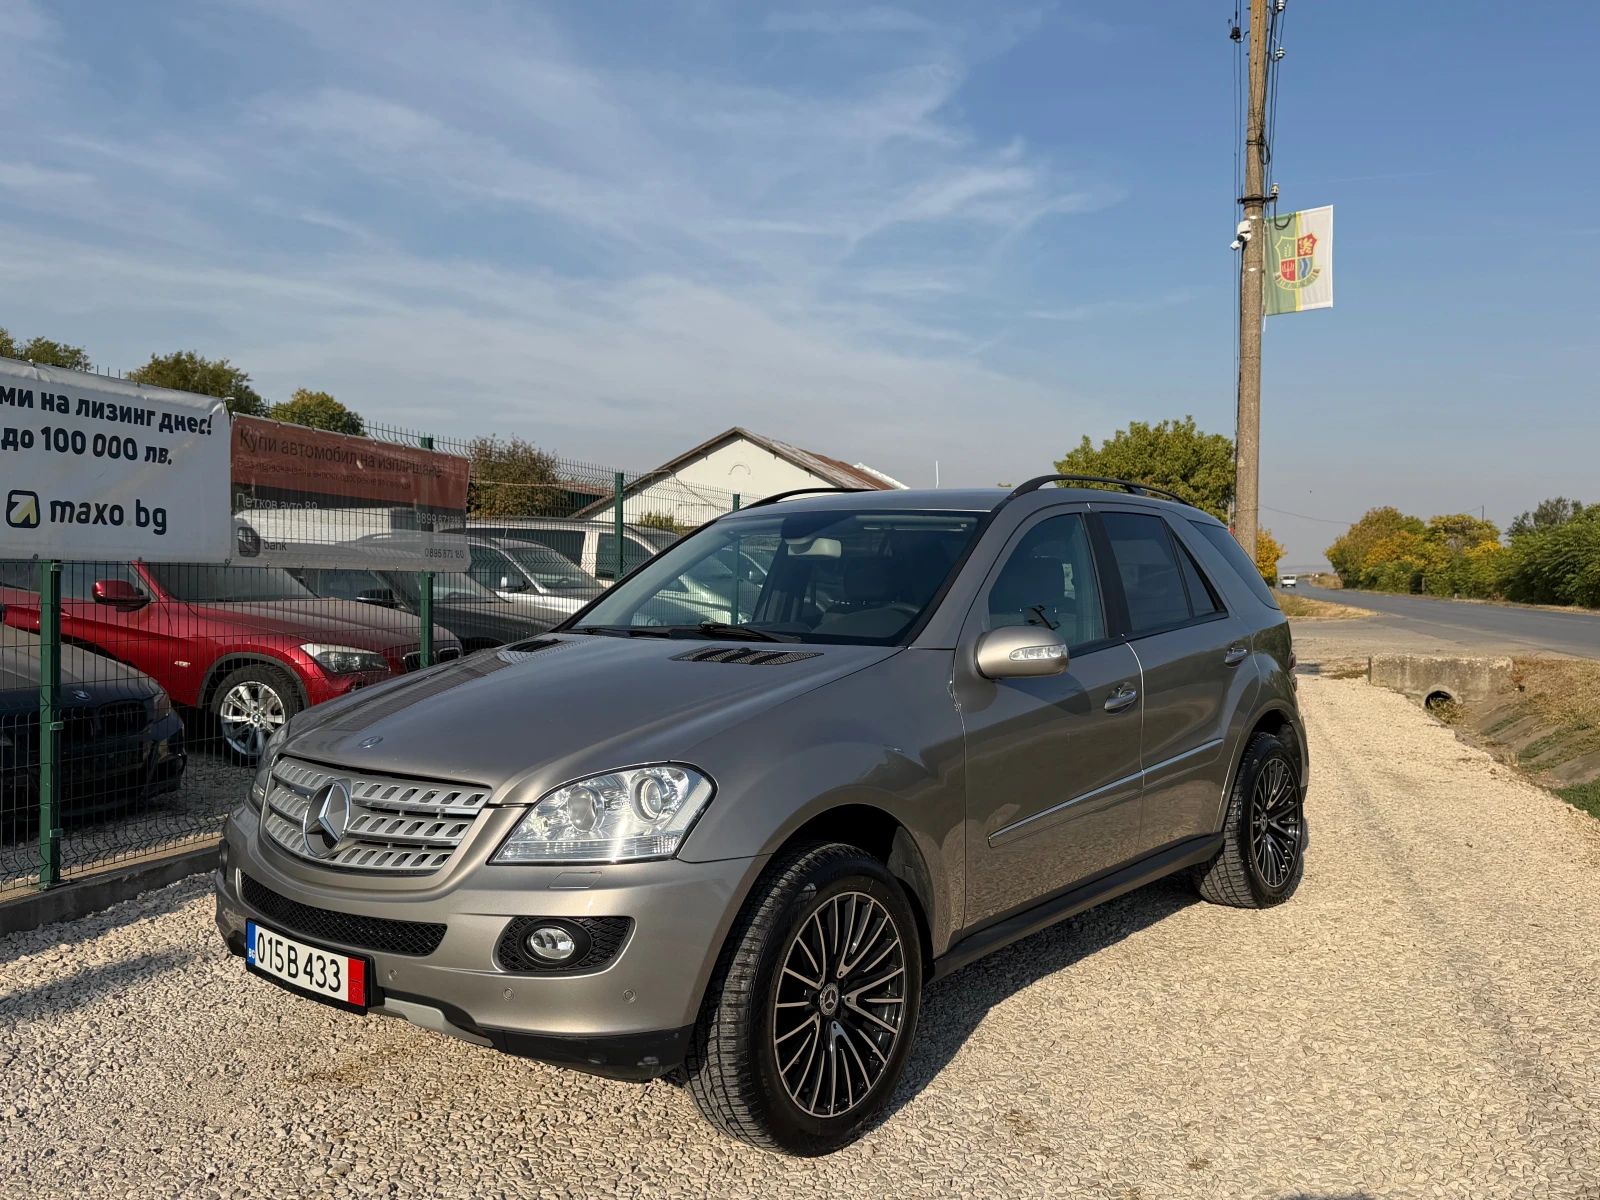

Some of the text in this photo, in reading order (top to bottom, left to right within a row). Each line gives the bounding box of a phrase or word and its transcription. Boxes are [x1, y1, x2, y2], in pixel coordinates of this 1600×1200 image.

[0, 385, 212, 435] ми на лизинг днес!
[1, 426, 172, 465] до 100 000 лв.
[239, 428, 443, 479] Купи автомобил на изплащане
[237, 457, 255, 469] Без
[236, 492, 278, 510] Петков
[416, 512, 436, 526] 0899
[263, 540, 287, 551] bank
[424, 548, 442, 558] 0895
[248, 947, 256, 959] BG
